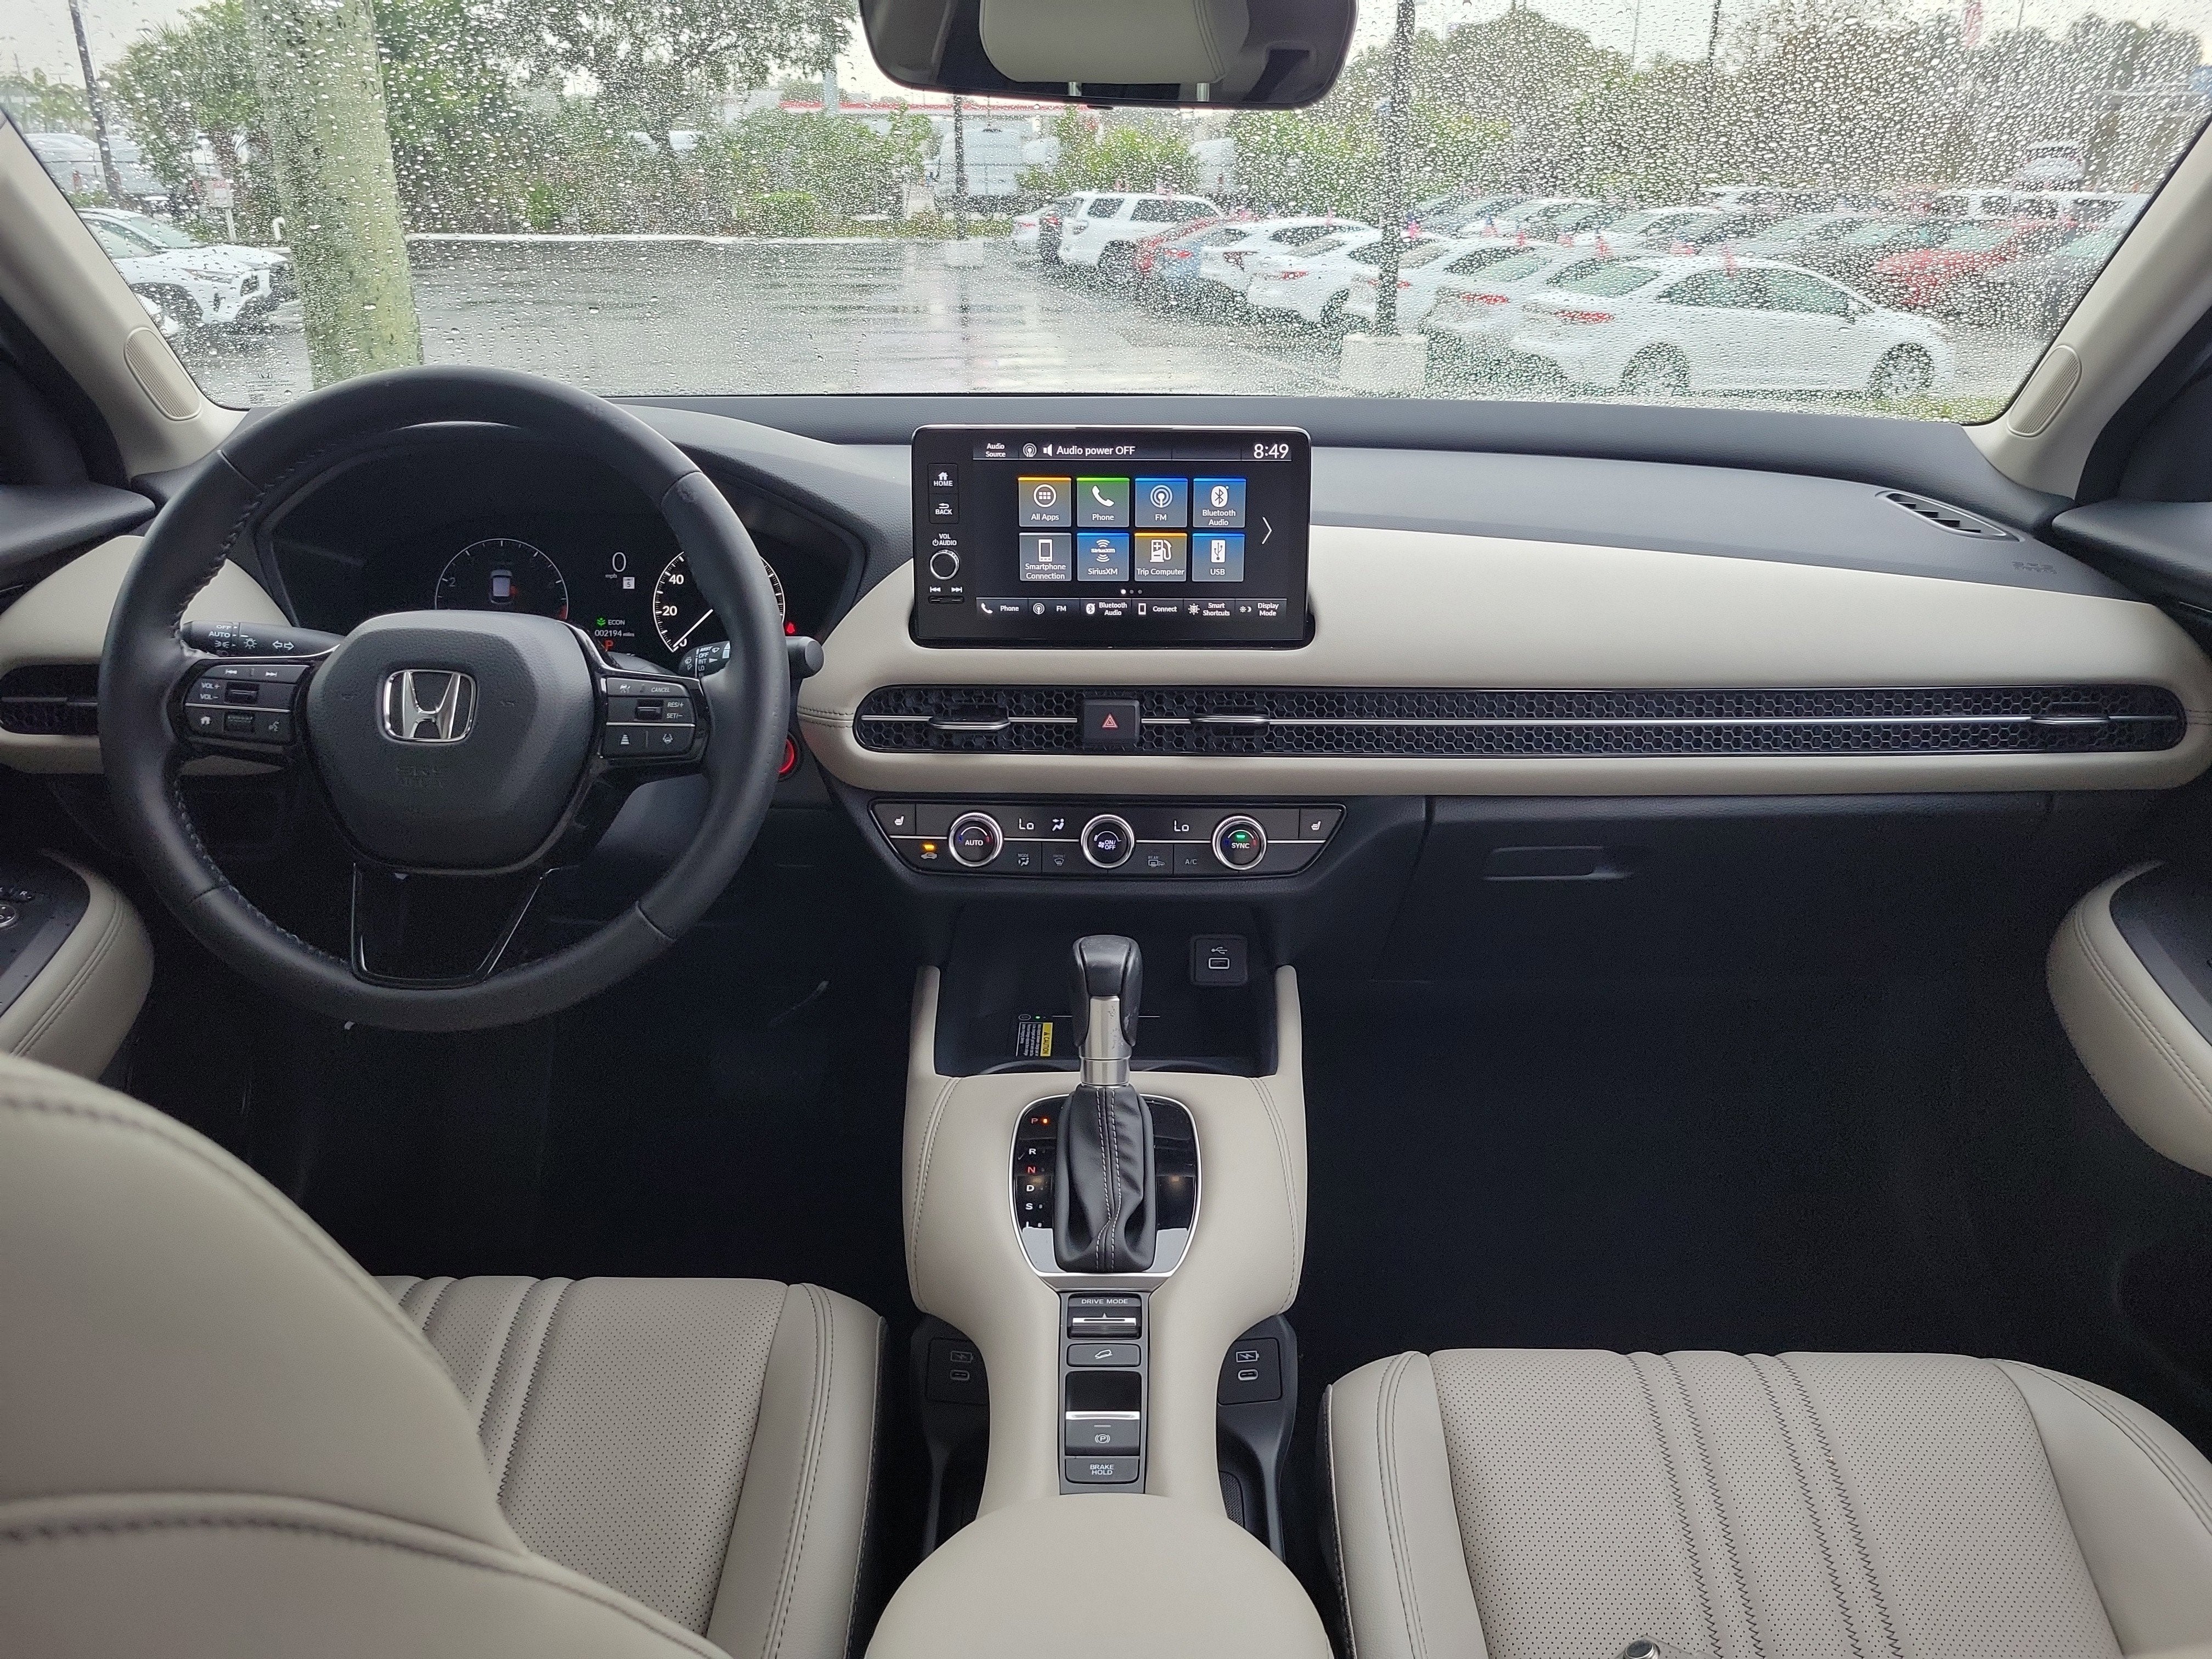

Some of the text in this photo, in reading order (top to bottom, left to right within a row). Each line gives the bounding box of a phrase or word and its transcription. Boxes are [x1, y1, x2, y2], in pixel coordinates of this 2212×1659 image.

[1056, 445, 1136, 456] Audio power OFF
[1253, 443, 1289, 459] 8:49
[1041, 514, 1059, 522] Apps
[612, 552, 627, 572] 0
[1025, 563, 1066, 571] Smartphone
[1136, 568, 1185, 577] Trip Computer
[449, 577, 456, 587] 2
[668, 574, 684, 585] 40
[662, 606, 678, 616] 20
[1018, 817, 1035, 830] Lo
[1173, 820, 1189, 832] Lo
